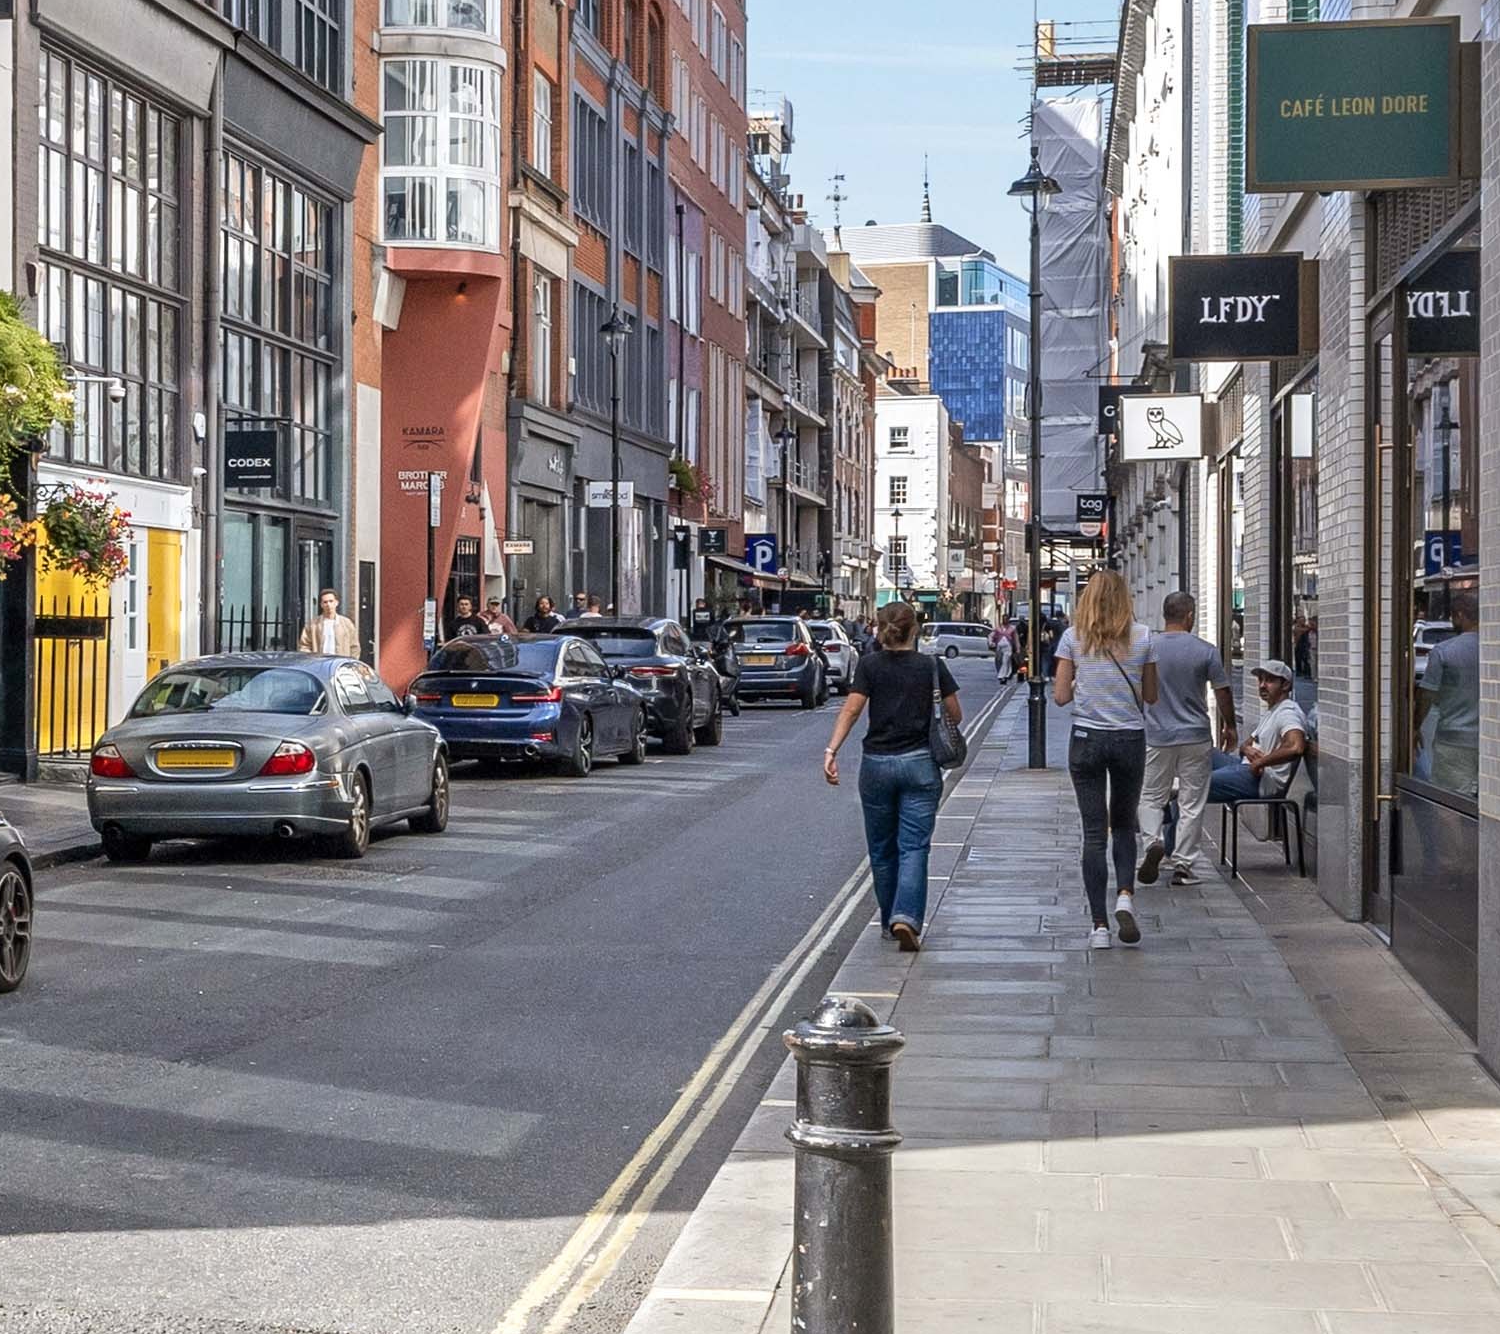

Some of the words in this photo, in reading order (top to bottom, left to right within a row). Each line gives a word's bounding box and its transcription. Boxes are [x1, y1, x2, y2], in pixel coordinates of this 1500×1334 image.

[1280, 93, 1325, 118] CAFÉ
[1332, 97, 1376, 116] LEON
[1382, 94, 1429, 114] DORE
[402, 426, 445, 436] KAMARA
[755, 545, 773, 571] P
